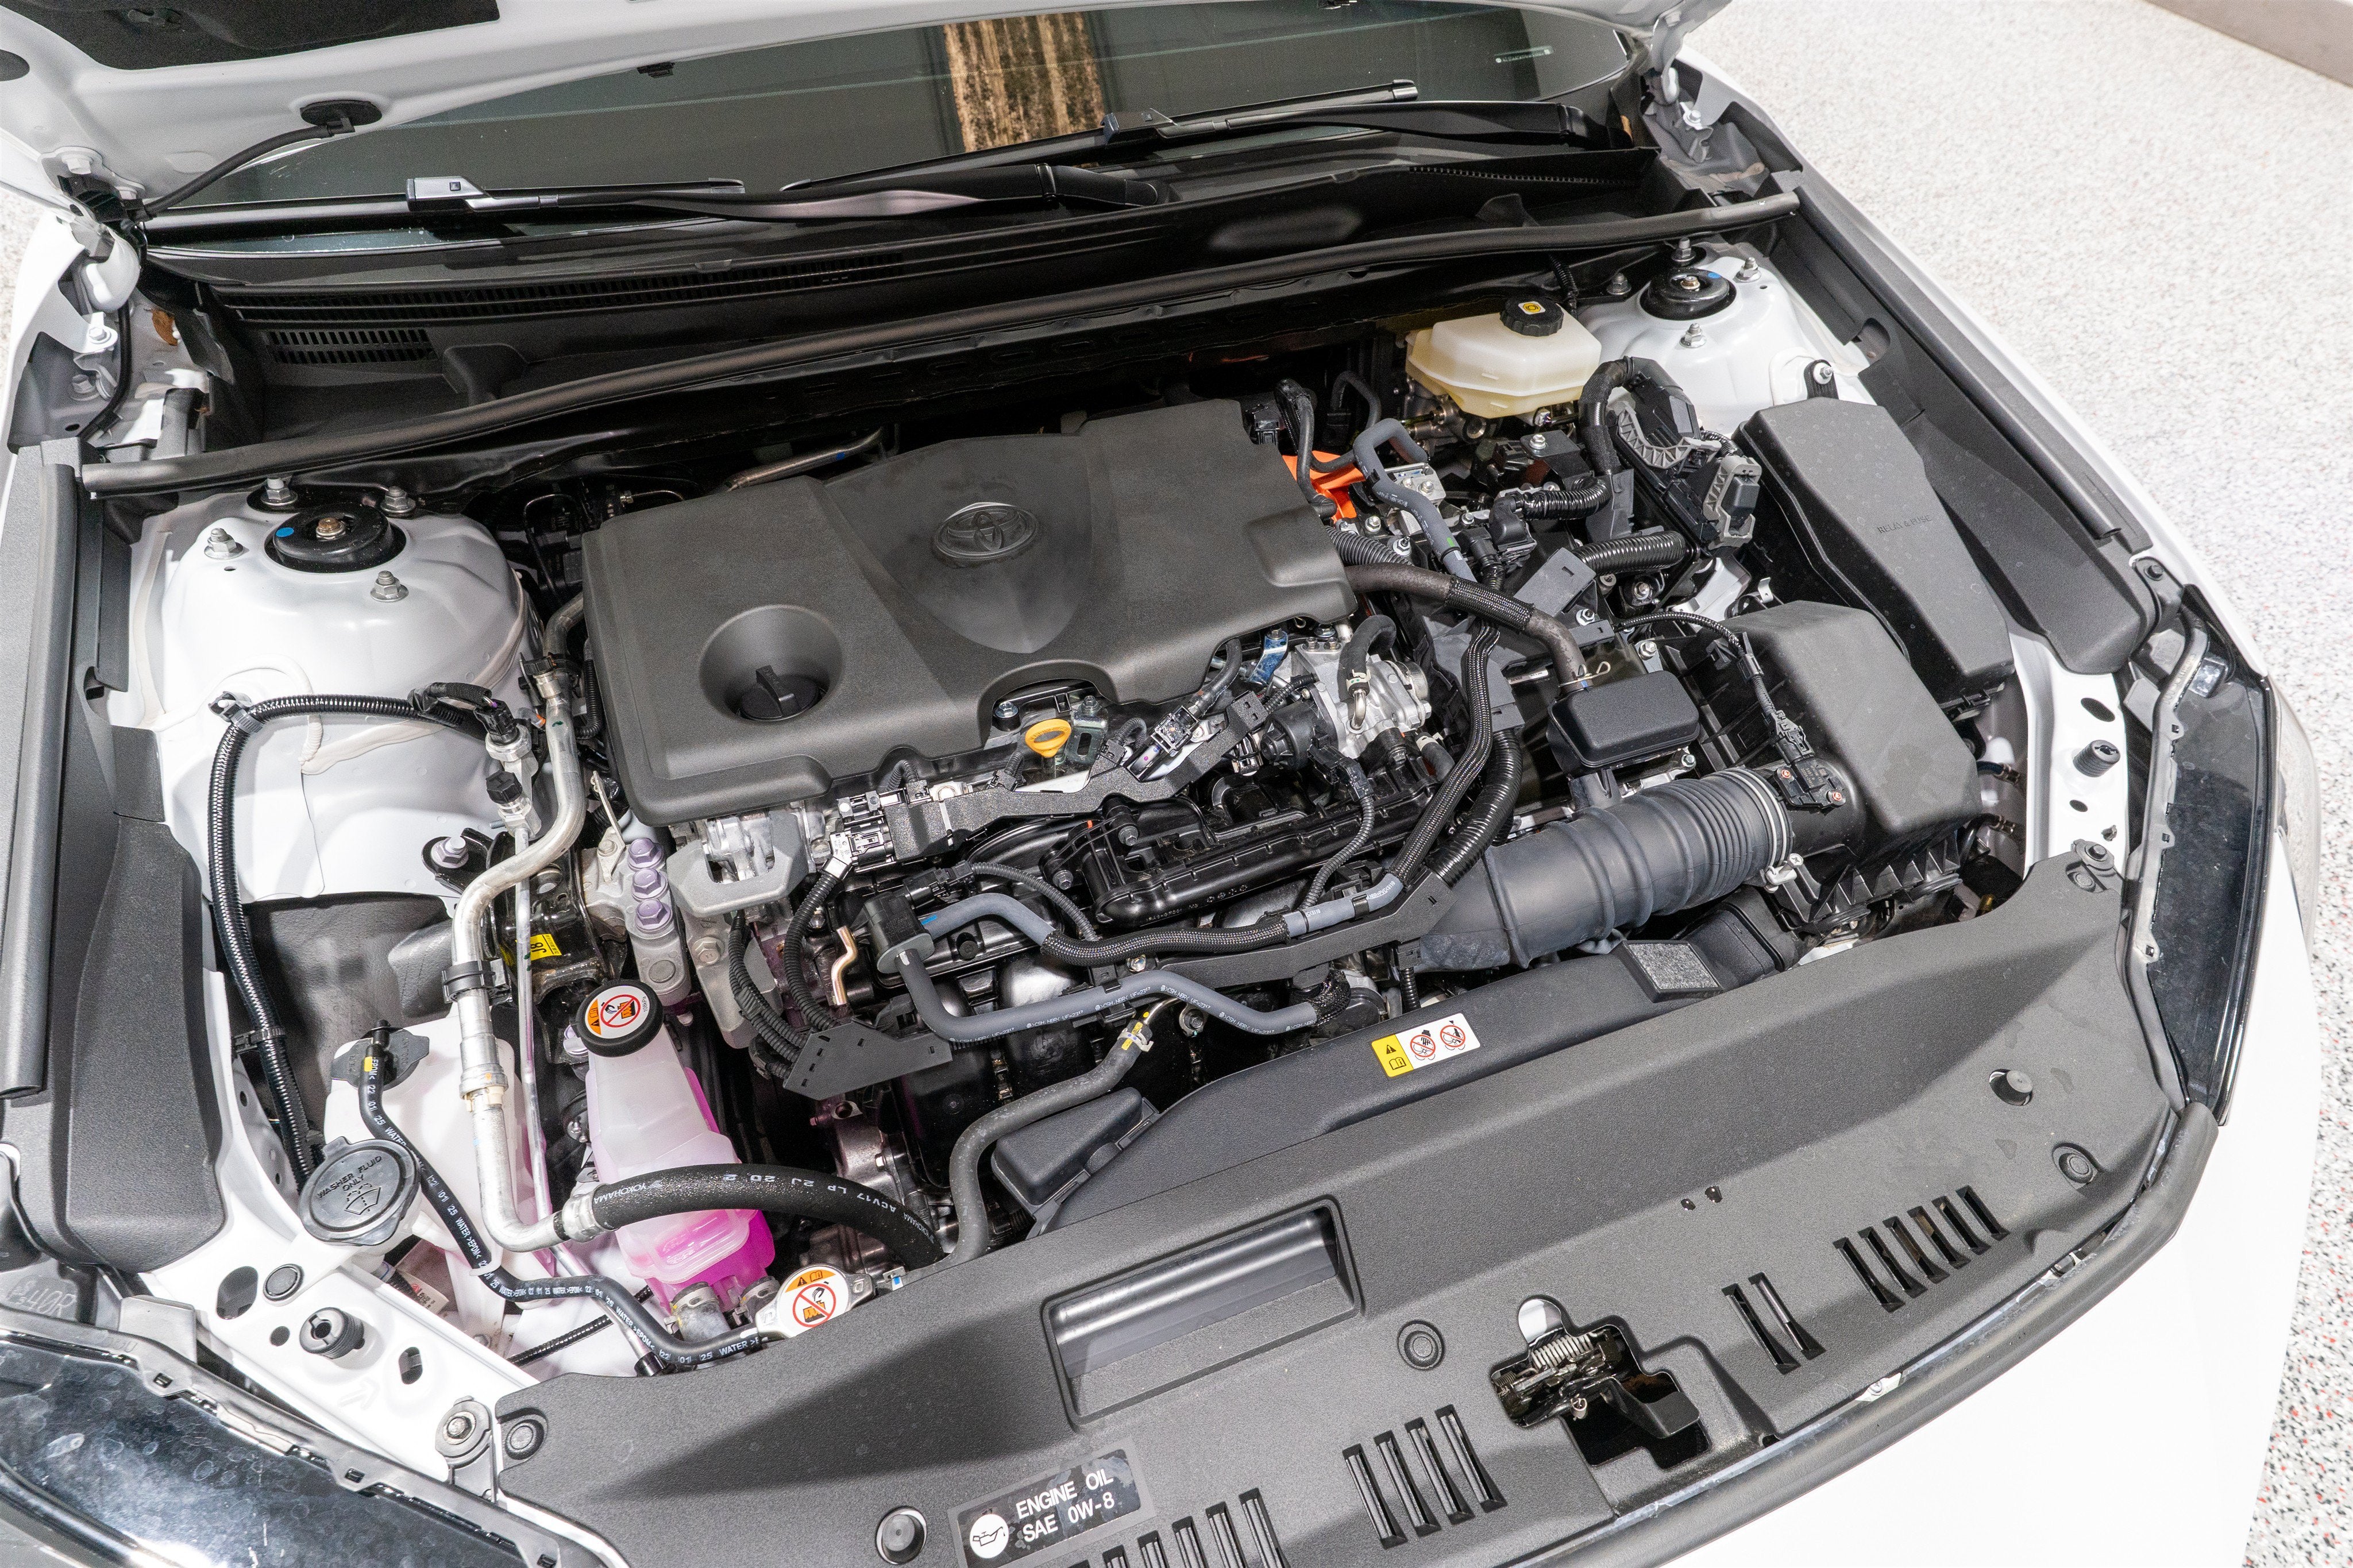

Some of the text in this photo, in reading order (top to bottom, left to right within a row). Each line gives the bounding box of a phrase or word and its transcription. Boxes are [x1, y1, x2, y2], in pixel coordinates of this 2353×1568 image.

[1877, 521, 1903, 533] RELAY
[1910, 515, 1931, 525] FUSE
[530, 943, 547, 953] J8
[317, 1156, 382, 1198] WASHER FLUID
[342, 1174, 364, 1191] ONLY
[593, 1183, 647, 1204] YOKOHAMA
[827, 1185, 847, 1194] LP
[857, 1193, 897, 1213] ACV17
[456, 1216, 470, 1238] WATER
[903, 1212, 931, 1238] YOKOHAMA
[499, 1285, 513, 1297] WATER
[615, 1306, 634, 1328] WATER
[719, 1341, 747, 1356] WATER
[1016, 1469, 1113, 1519] ENGINE OIL
[1022, 1492, 1115, 1543] SAE 0W-8
